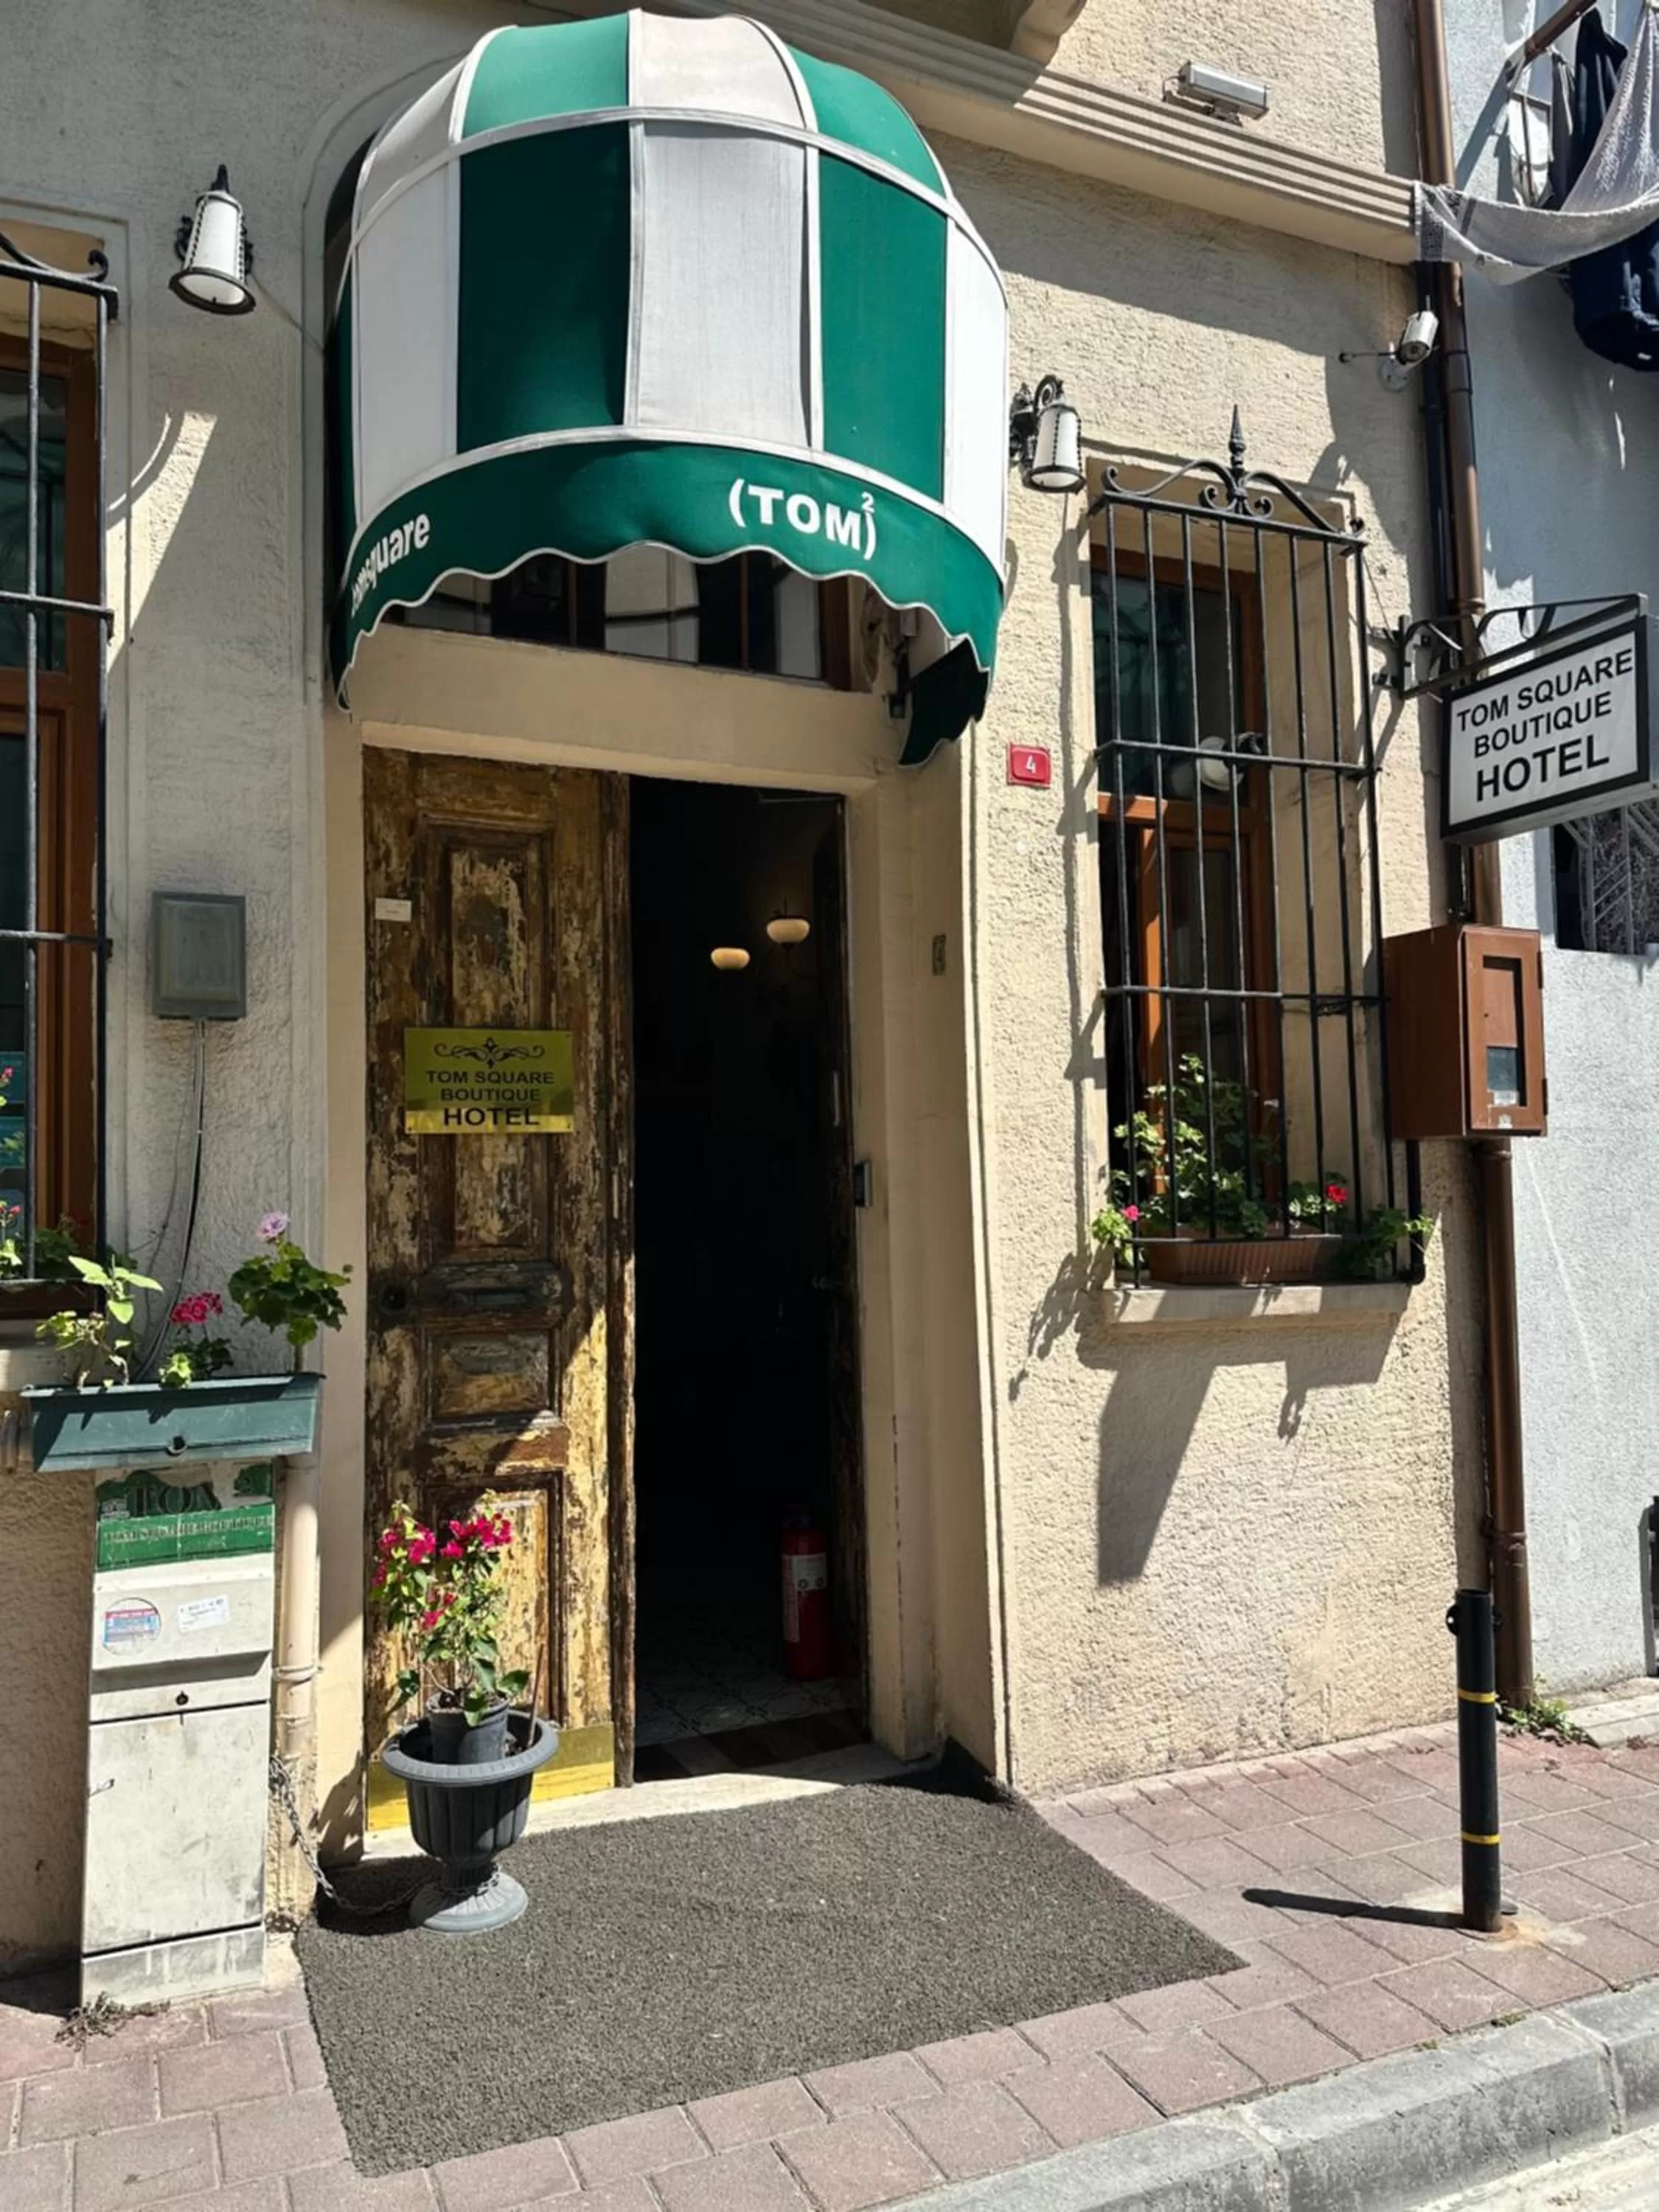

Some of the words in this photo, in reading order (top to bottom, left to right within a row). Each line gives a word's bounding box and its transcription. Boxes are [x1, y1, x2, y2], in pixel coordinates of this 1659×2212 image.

[1457, 695, 1508, 731] TOM
[1517, 648, 1632, 710] SQUARE
[1475, 691, 1612, 758] BOUTIQUE
[1026, 754, 1037, 774] 4
[1476, 734, 1610, 802] HOTEL
[425, 1071, 468, 1084] TOM
[474, 1071, 554, 1084] SQUARE
[440, 1088, 540, 1102] BOUTIQUE
[443, 1107, 540, 1126] HOTEL
